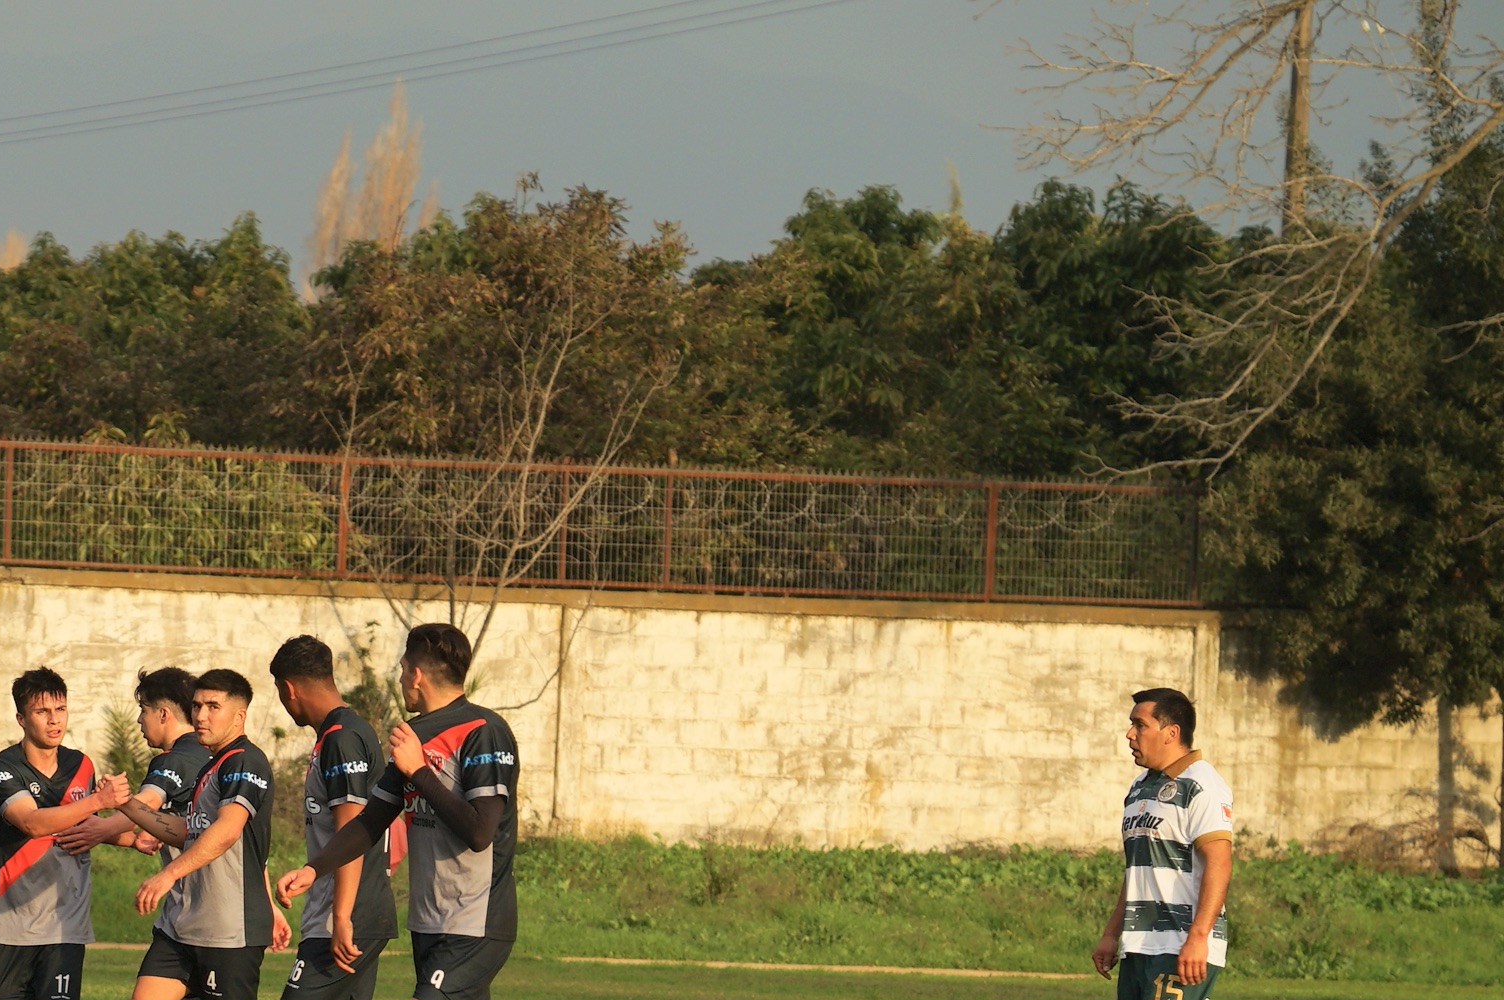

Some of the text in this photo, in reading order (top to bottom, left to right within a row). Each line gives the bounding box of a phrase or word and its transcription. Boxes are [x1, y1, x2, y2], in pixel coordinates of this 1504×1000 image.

[55, 974, 70, 994] 11
[206, 969, 217, 991] 4
[430, 969, 445, 990] 9
